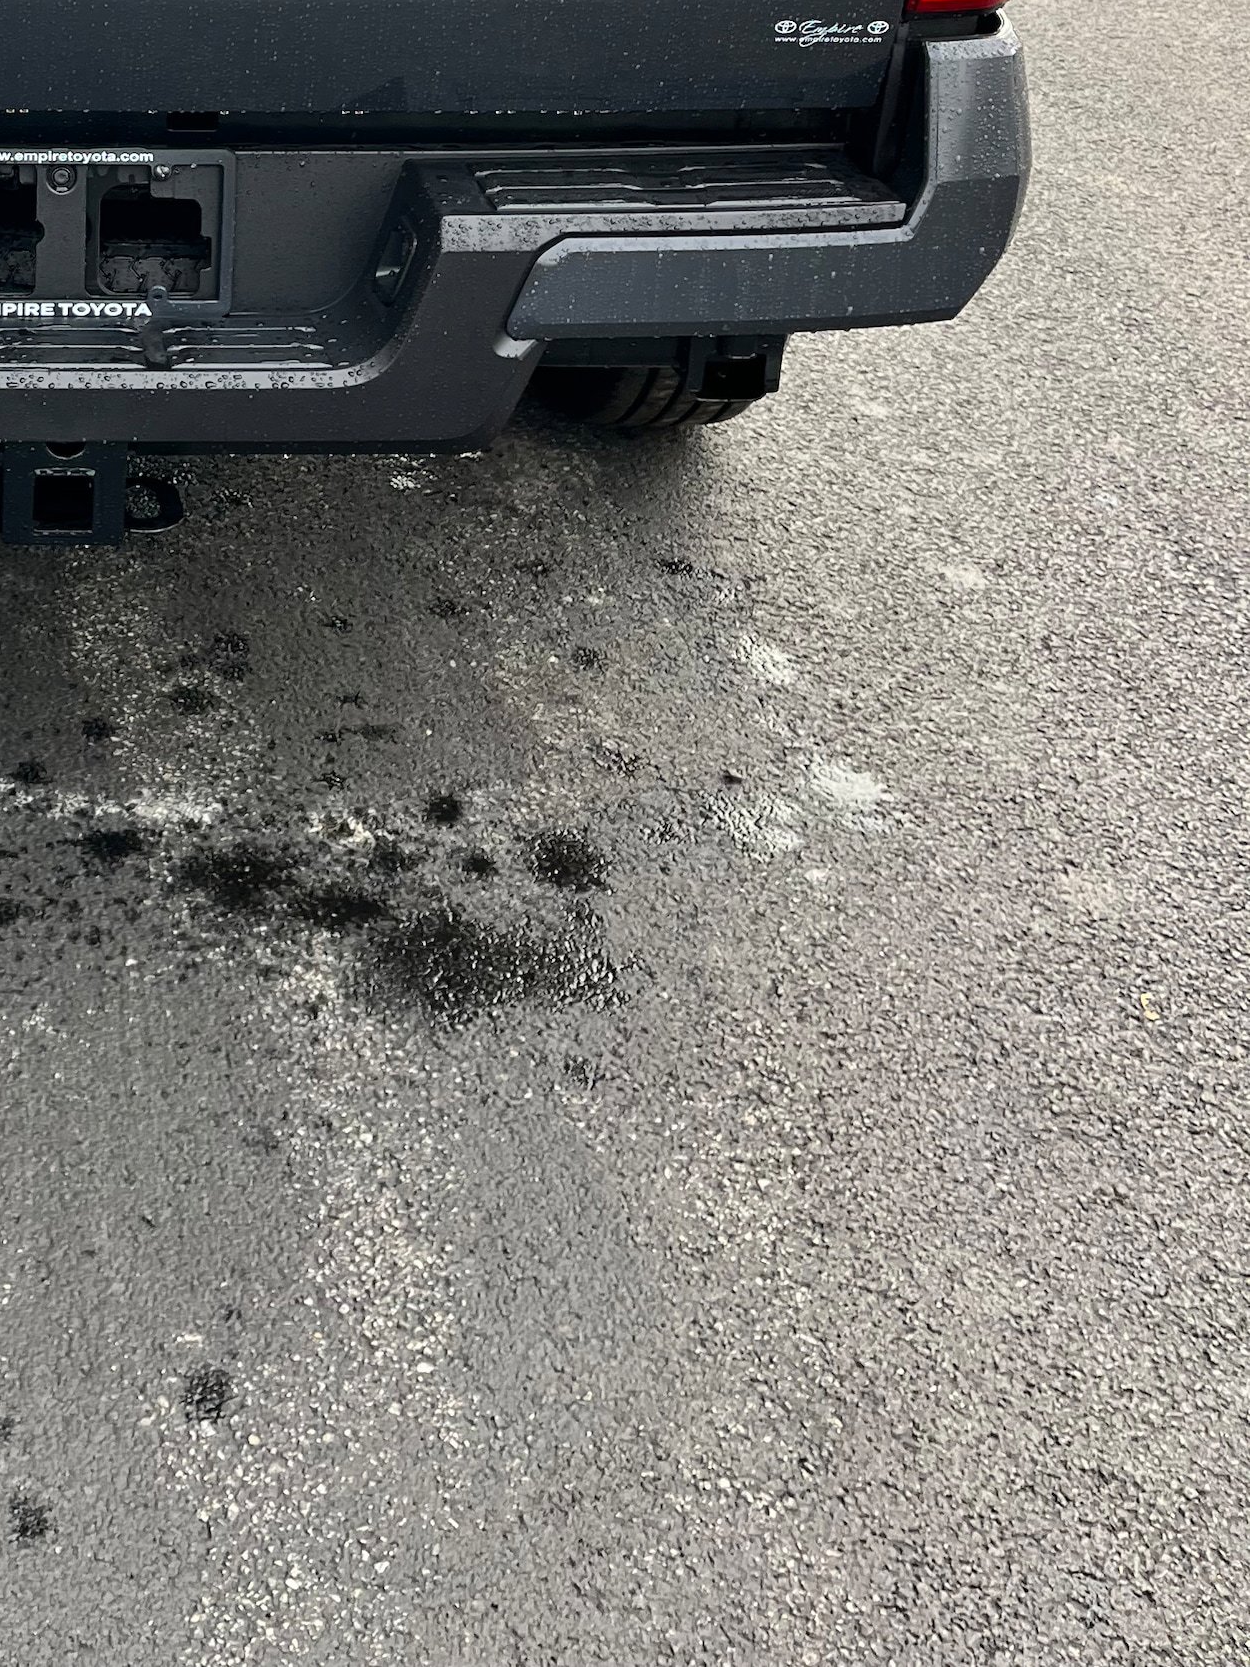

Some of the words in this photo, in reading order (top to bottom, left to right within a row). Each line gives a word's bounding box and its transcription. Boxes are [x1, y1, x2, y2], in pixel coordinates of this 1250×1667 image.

[774, 35, 882, 44] www.empiretoyota.com
[799, 19, 864, 47] Empire
[58, 302, 152, 317] TOYOTA
